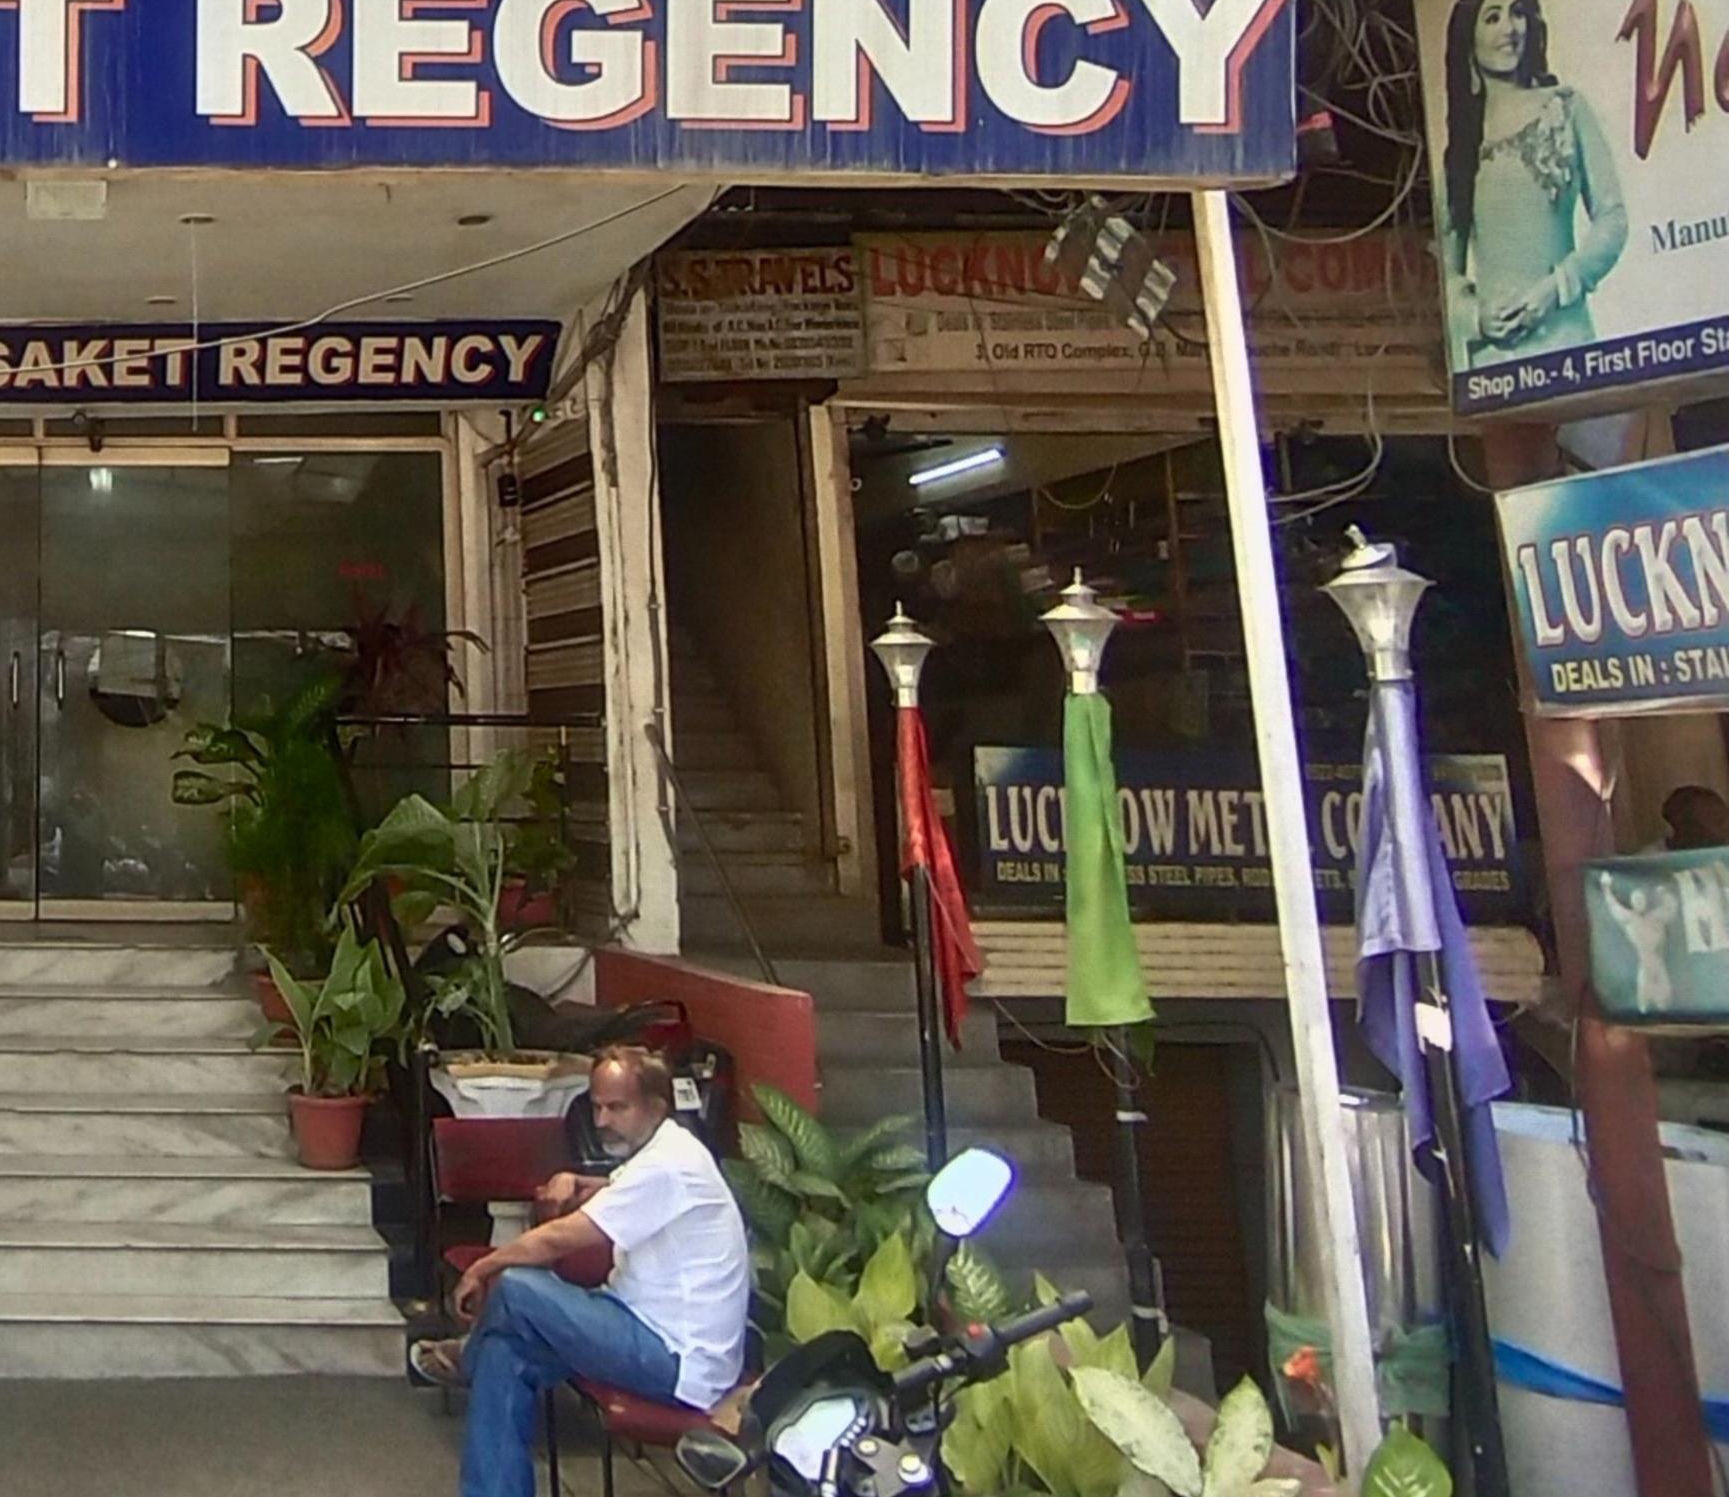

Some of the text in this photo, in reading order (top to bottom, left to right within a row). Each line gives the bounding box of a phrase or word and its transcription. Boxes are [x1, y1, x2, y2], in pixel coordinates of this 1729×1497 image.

[871, 244, 1113, 298] LUCKNO
[218, 334, 543, 387] REGENCY
[992, 342, 1019, 360] Old
[1023, 343, 1057, 360] RTO
[1467, 372, 1515, 400] Shop
[1585, 349, 1632, 377] First
[1637, 335, 1695, 368] Floor
[1551, 656, 1624, 693] DEALS
[1628, 653, 1656, 686] IN
[986, 784, 1507, 860] LUCOW MET COANY
[997, 860, 1042, 882] DEALS
